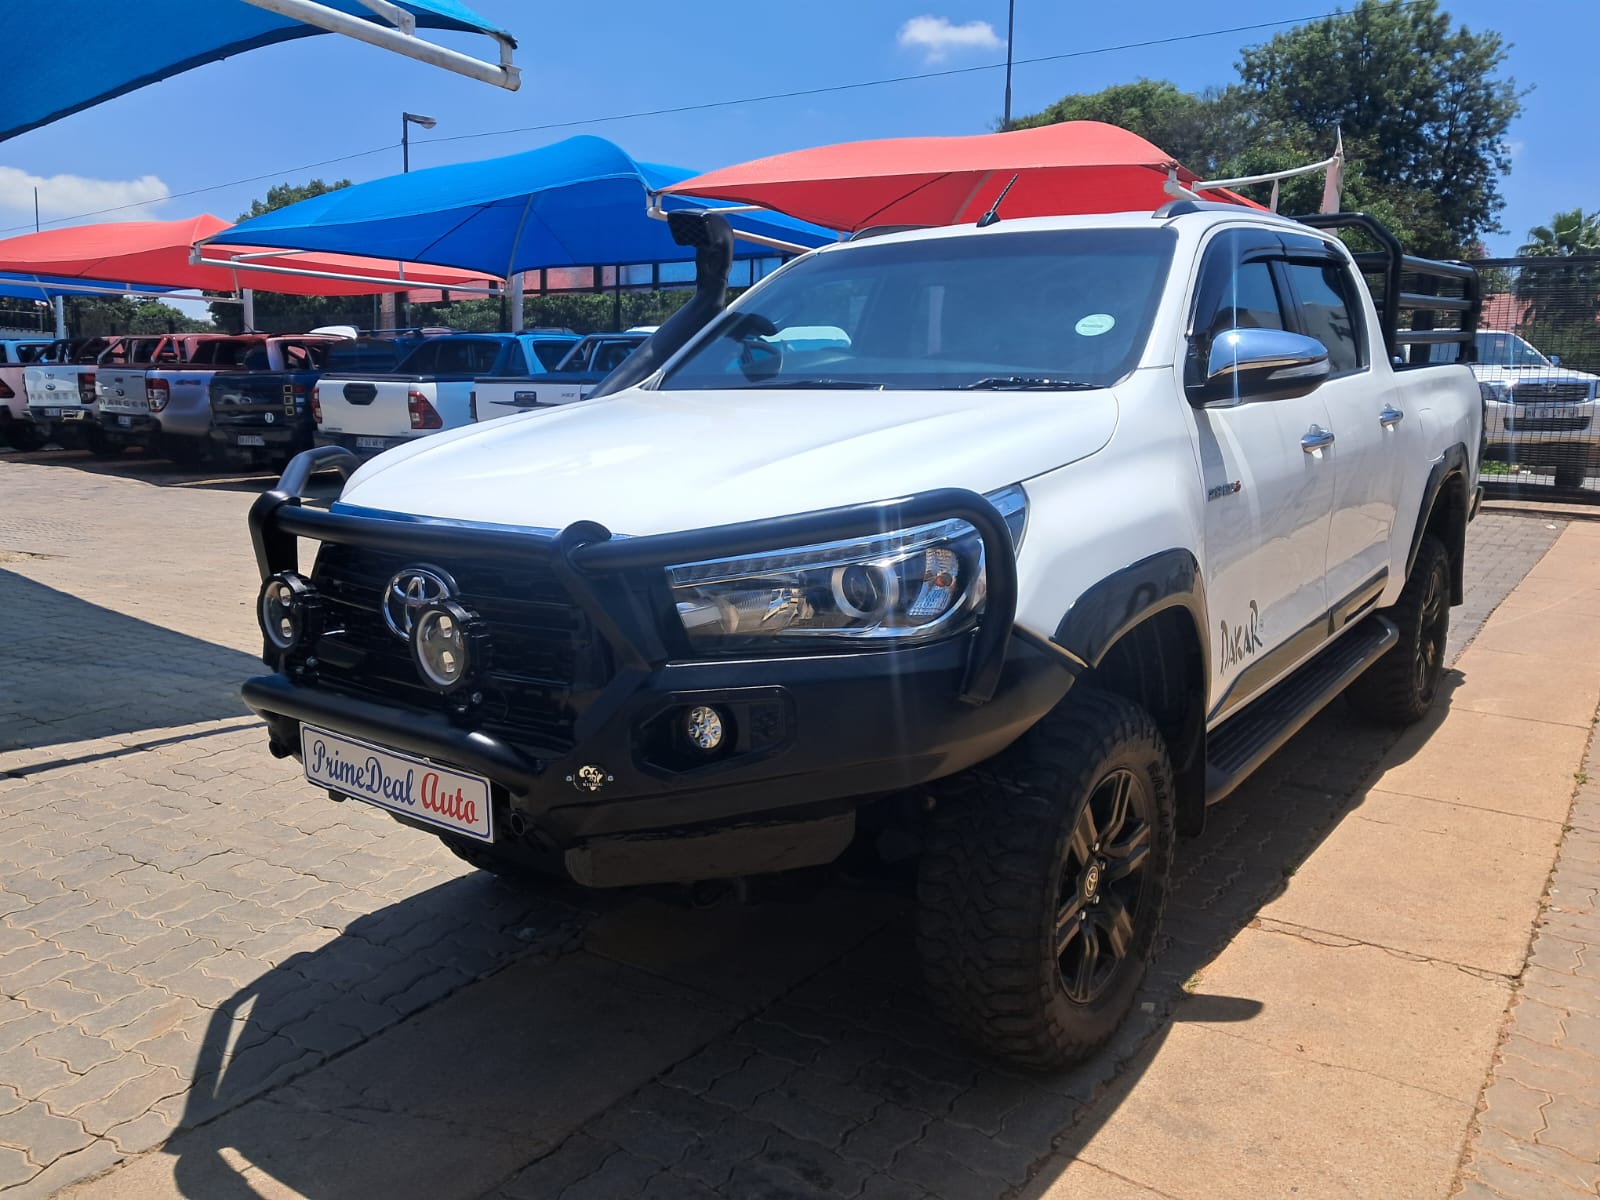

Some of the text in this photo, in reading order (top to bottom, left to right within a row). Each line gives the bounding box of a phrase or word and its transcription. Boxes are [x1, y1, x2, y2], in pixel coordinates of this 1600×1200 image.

[1220, 600, 1263, 674] DAKAR
[313, 740, 479, 824] PrimeDeal Auto
